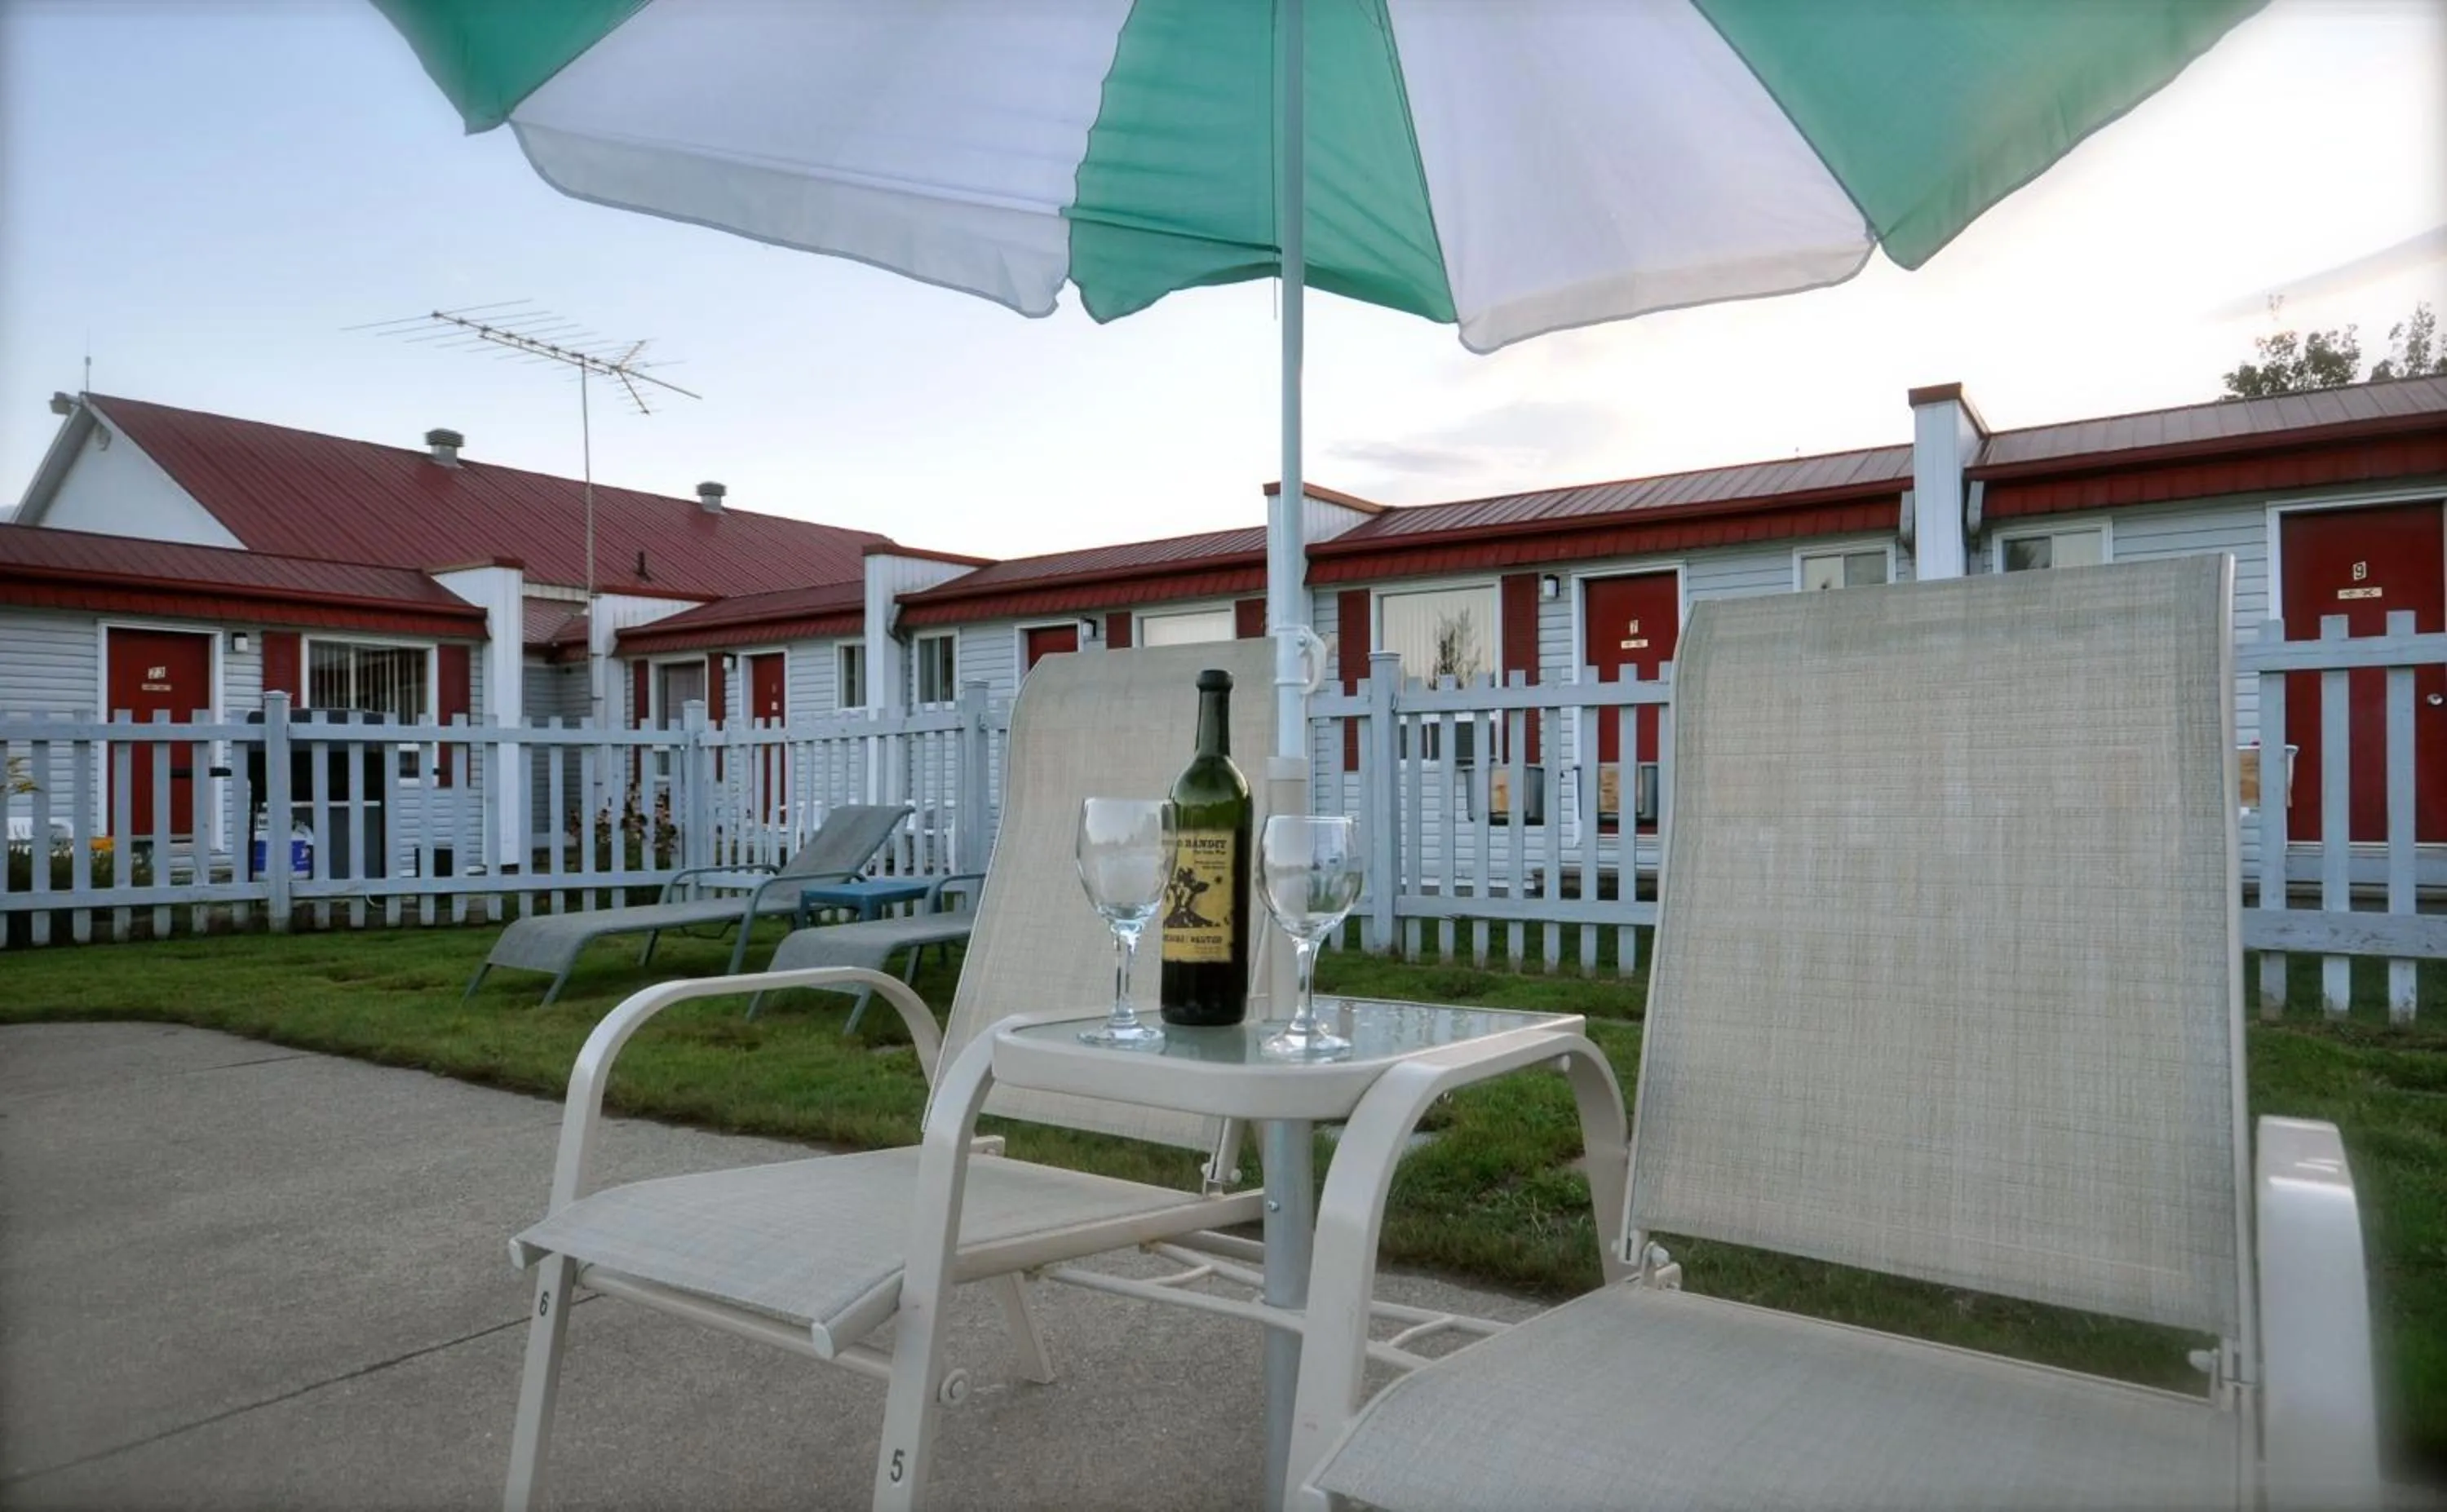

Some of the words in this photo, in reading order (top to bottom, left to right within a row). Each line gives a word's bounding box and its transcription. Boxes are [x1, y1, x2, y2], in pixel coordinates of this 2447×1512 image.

[2355, 564, 2365, 578] 9
[539, 1291, 549, 1316] 6
[891, 1448, 905, 1483] 5
